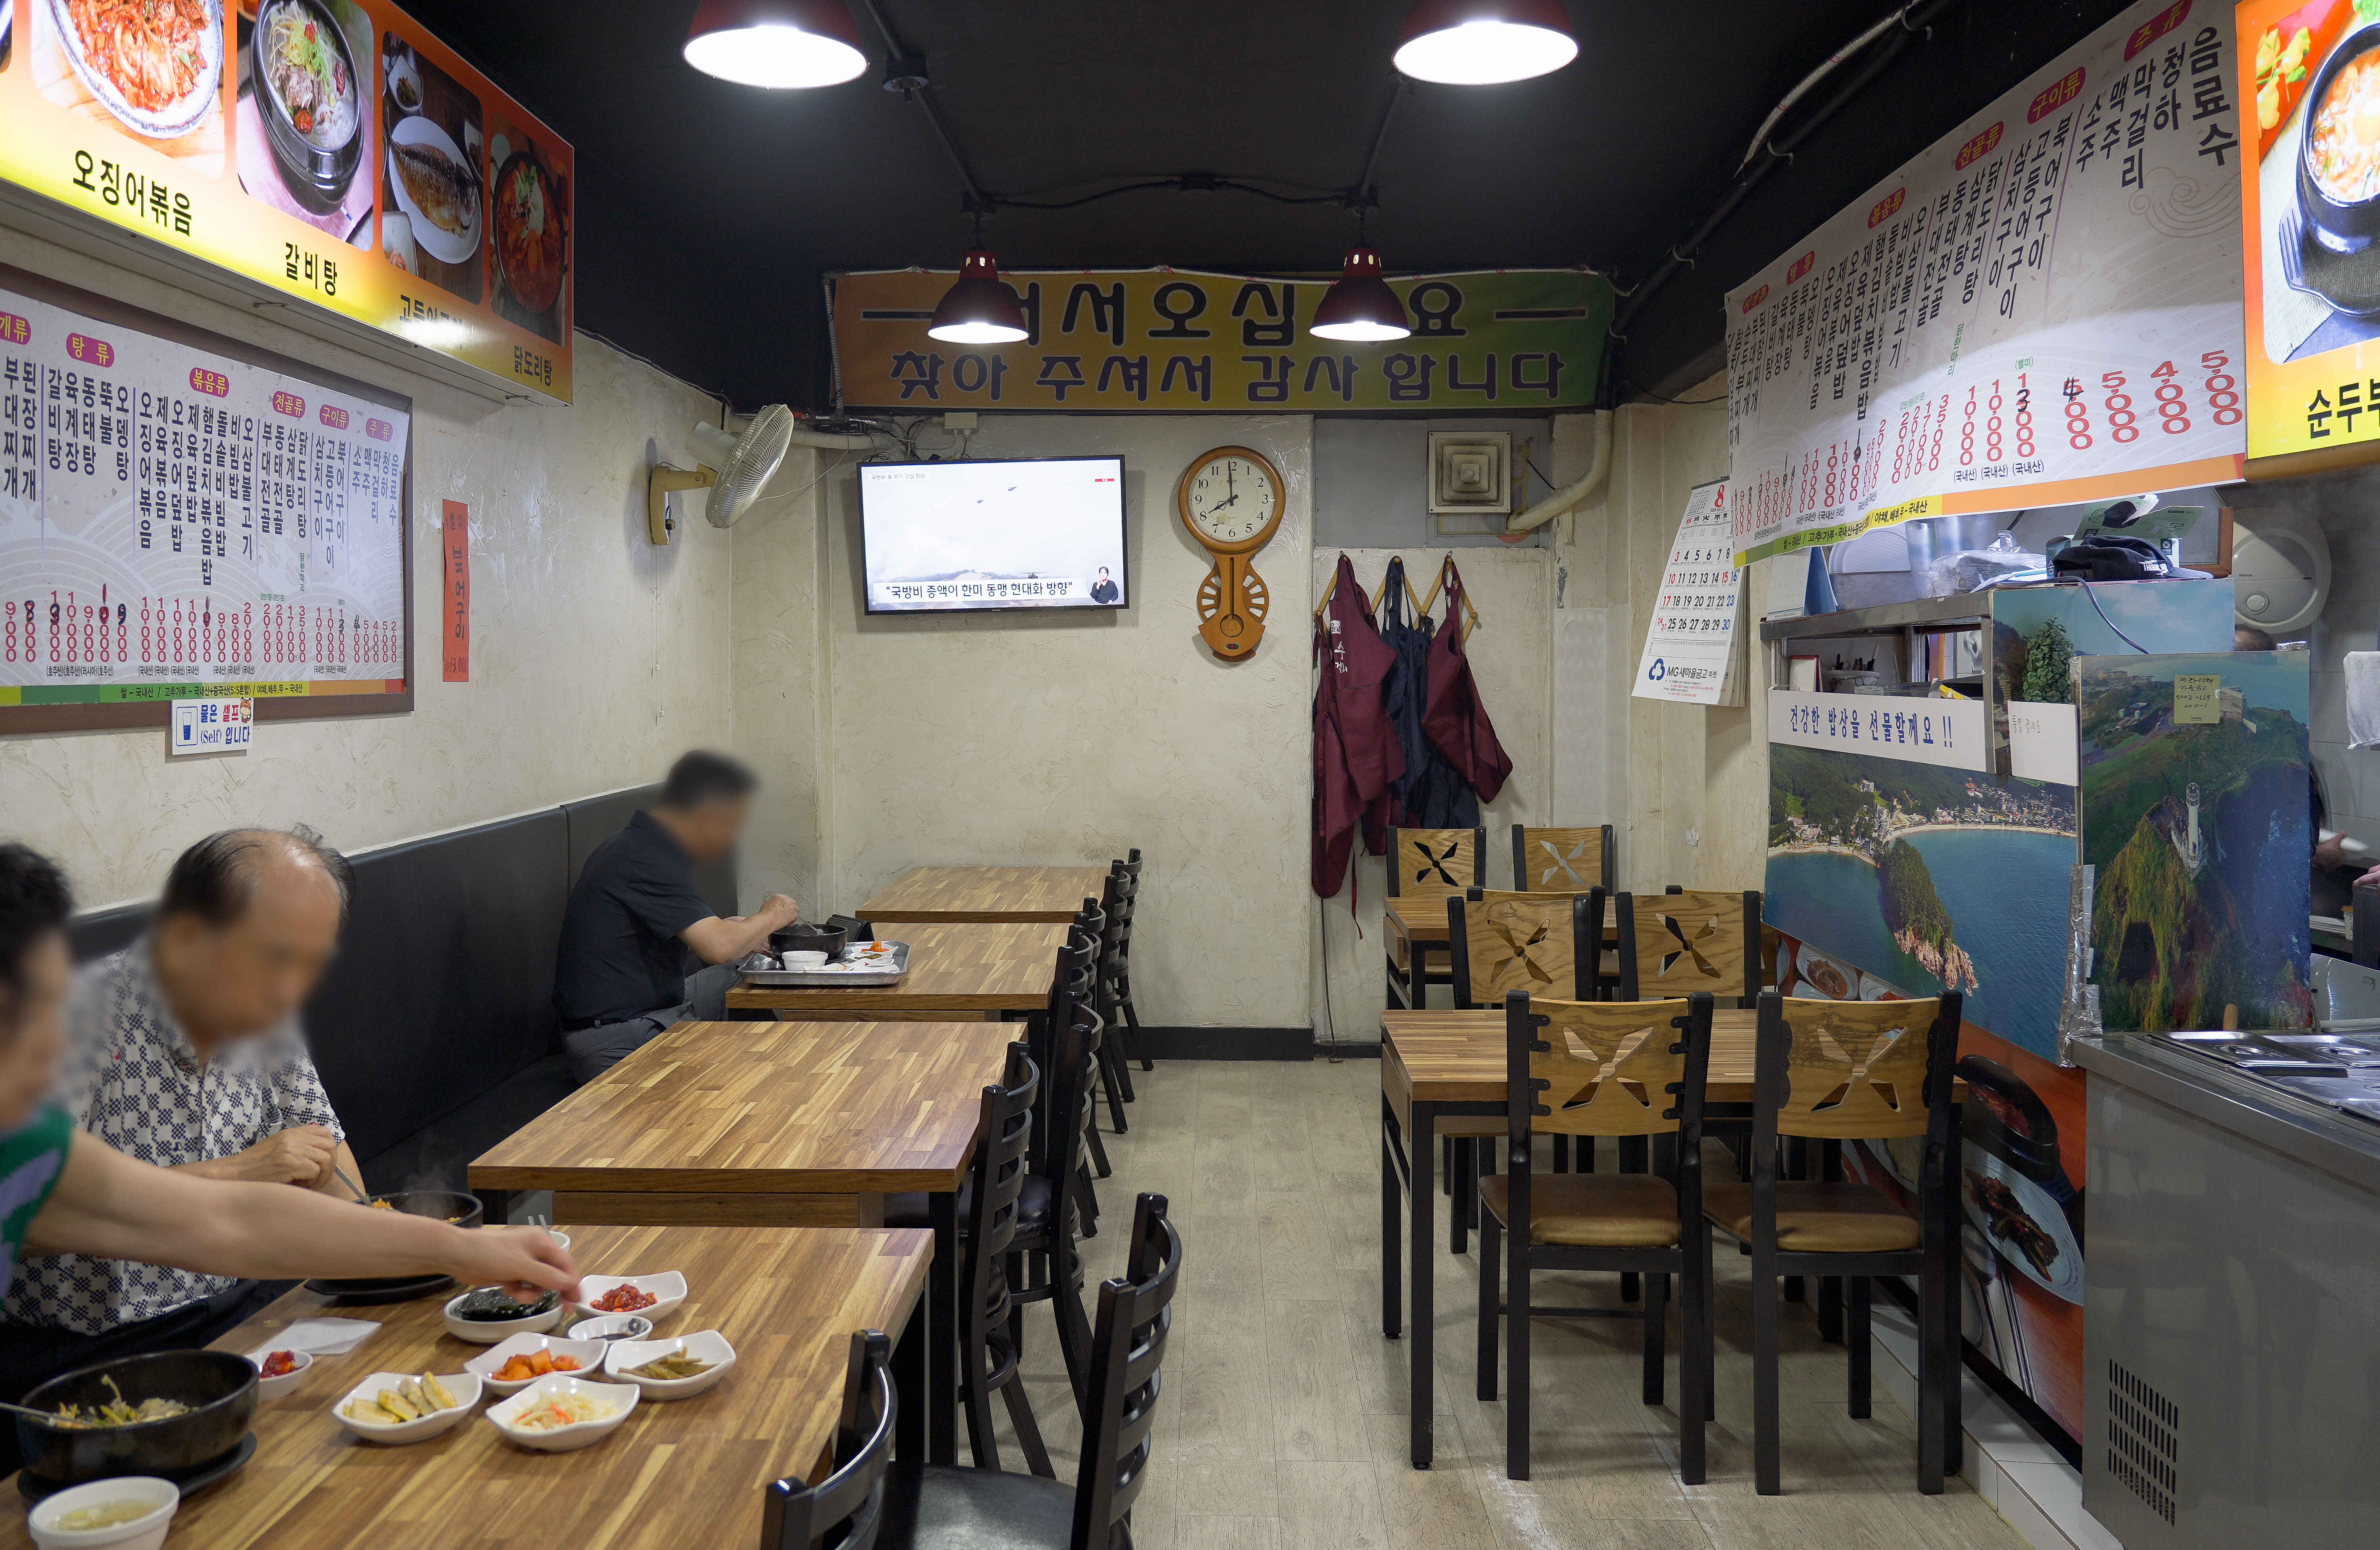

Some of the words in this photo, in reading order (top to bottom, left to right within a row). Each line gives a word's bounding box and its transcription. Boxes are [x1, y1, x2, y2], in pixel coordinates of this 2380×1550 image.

[2032, 70, 2080, 119] 구이류
[2099, 72, 2130, 160] 맥주
[2121, 57, 2157, 190] 막걸리
[2153, 41, 2186, 131] 청하
[2188, 26, 2239, 167] 음료수
[1959, 124, 1999, 167] 전골류
[2076, 93, 2102, 173] 소주
[73, 148, 192, 237] 오징어볶음
[1871, 190, 1903, 225] 볶음류
[1953, 166, 1986, 276] 삼계탕
[1989, 138, 2032, 289] 삼치구이
[2000, 128, 2051, 319] 고등어구이
[2028, 111, 2074, 271] 북어구이
[285, 240, 338, 296] 갈비탕
[1889, 212, 1914, 313] 비빔밥
[1917, 189, 1951, 328] 부대전골
[1929, 179, 1968, 320] 동태전골
[1962, 156, 2003, 305] 닭도리탕
[998, 280, 1468, 348] 서오십요
[1796, 282, 1810, 338] 뚝불
[1803, 277, 1819, 361] 오뎅탕
[1823, 255, 1849, 376] 제육볶음
[1833, 250, 1859, 400] 오징어덮밥
[1851, 239, 1873, 364] 제육덮밥
[1857, 230, 1887, 421] 햄김치볶음밥
[1889, 206, 1927, 369] 오삼불고기
[514, 345, 553, 387] 닭도리탕
[1750, 309, 1767, 413] 된장찌개
[1765, 302, 1779, 381] 갈비탕
[1774, 295, 1788, 376] 육계장
[1784, 289, 1799, 371] 동태탕
[1810, 266, 1835, 411] 오징어볶음
[99, 380, 113, 446] 뚝불
[193, 369, 227, 397] 볶음류
[275, 393, 303, 417] 전골류
[890, 350, 1009, 401] 찾아
[1035, 354, 1212, 402] 주셔서
[2101, 370, 2140, 443] 5,000
[2150, 360, 2191, 434] 4,000
[2201, 349, 2243, 426] 5,000
[4, 356, 19, 499] 부대찌개
[22, 361, 37, 501] 된장찌개
[48, 368, 62, 470] 갈비탕
[65, 372, 79, 473] 육계장
[82, 376, 96, 476] 동태탕
[116, 386, 129, 482] 오뎅탕
[229, 414, 241, 500] 비빔밥
[322, 407, 348, 429] 구이류
[139, 392, 153, 549] 오징어볶음
[155, 396, 169, 519] 제육볶음
[171, 399, 184, 552] 오징어덮밥
[186, 403, 200, 524] 제육덮밥
[201, 406, 214, 586] 햄김치볶음밥
[215, 410, 228, 557] 돌솥비빔밥
[241, 417, 254, 560] 오삼불고기
[260, 421, 273, 534] 부대전골
[273, 423, 285, 535] 동태전골
[286, 428, 298, 509] 삼계탕
[296, 431, 309, 539] 닭도리탕
[314, 435, 325, 541] 삼치구이
[336, 440, 347, 544] 북어구이
[352, 445, 362, 495] 소주
[362, 448, 372, 496] 맥주
[371, 449, 382, 524] 막걸리
[381, 451, 391, 501] 청하
[389, 453, 400, 526] 음료수
[1198, 479, 1209, 489] 10
[1211, 466, 1219, 476] 11
[1246, 465, 1250, 475] 1
[1257, 477, 1264, 488] 2
[1714, 484, 1725, 508] 8
[1953, 467, 1977, 484] (국내산)
[1981, 464, 2008, 480] (국내산)
[2012, 459, 2044, 476] (국내산)
[325, 439, 336, 569] 고등어구이
[1195, 495, 1202, 505] 9
[1200, 511, 1207, 521] 8
[1212, 524, 1219, 534] 7
[1228, 528, 1236, 538] 6
[1245, 523, 1252, 533] 5
[1256, 511, 1264, 521] 4
[1261, 494, 1269, 504] 3
[67, 592, 77, 663] 10,000
[926, 583, 958, 598] 증액이
[961, 583, 983, 597] 한미
[986, 582, 1007, 597] 동맹
[1010, 582, 1043, 596] 현대화
[5, 601, 17, 662] 9,000
[84, 605, 94, 663] 9,000
[141, 596, 151, 663] 10,000
[157, 597, 166, 663] 10,000
[218, 613, 226, 663] 9,000
[231, 613, 240, 663] 8,000
[136, 686, 154, 698] 국내산
[165, 686, 187, 698] 고추가루
[289, 683, 303, 693] 국내산
[1666, 666, 1708, 679] MG새마을금고
[201, 704, 217, 723] 물은
[223, 704, 239, 722] 셀프
[201, 728, 222, 745] (Self)
[225, 726, 250, 745] 입니다
[1790, 705, 1819, 735] 건강한
[1828, 707, 1861, 739] 밥상을
